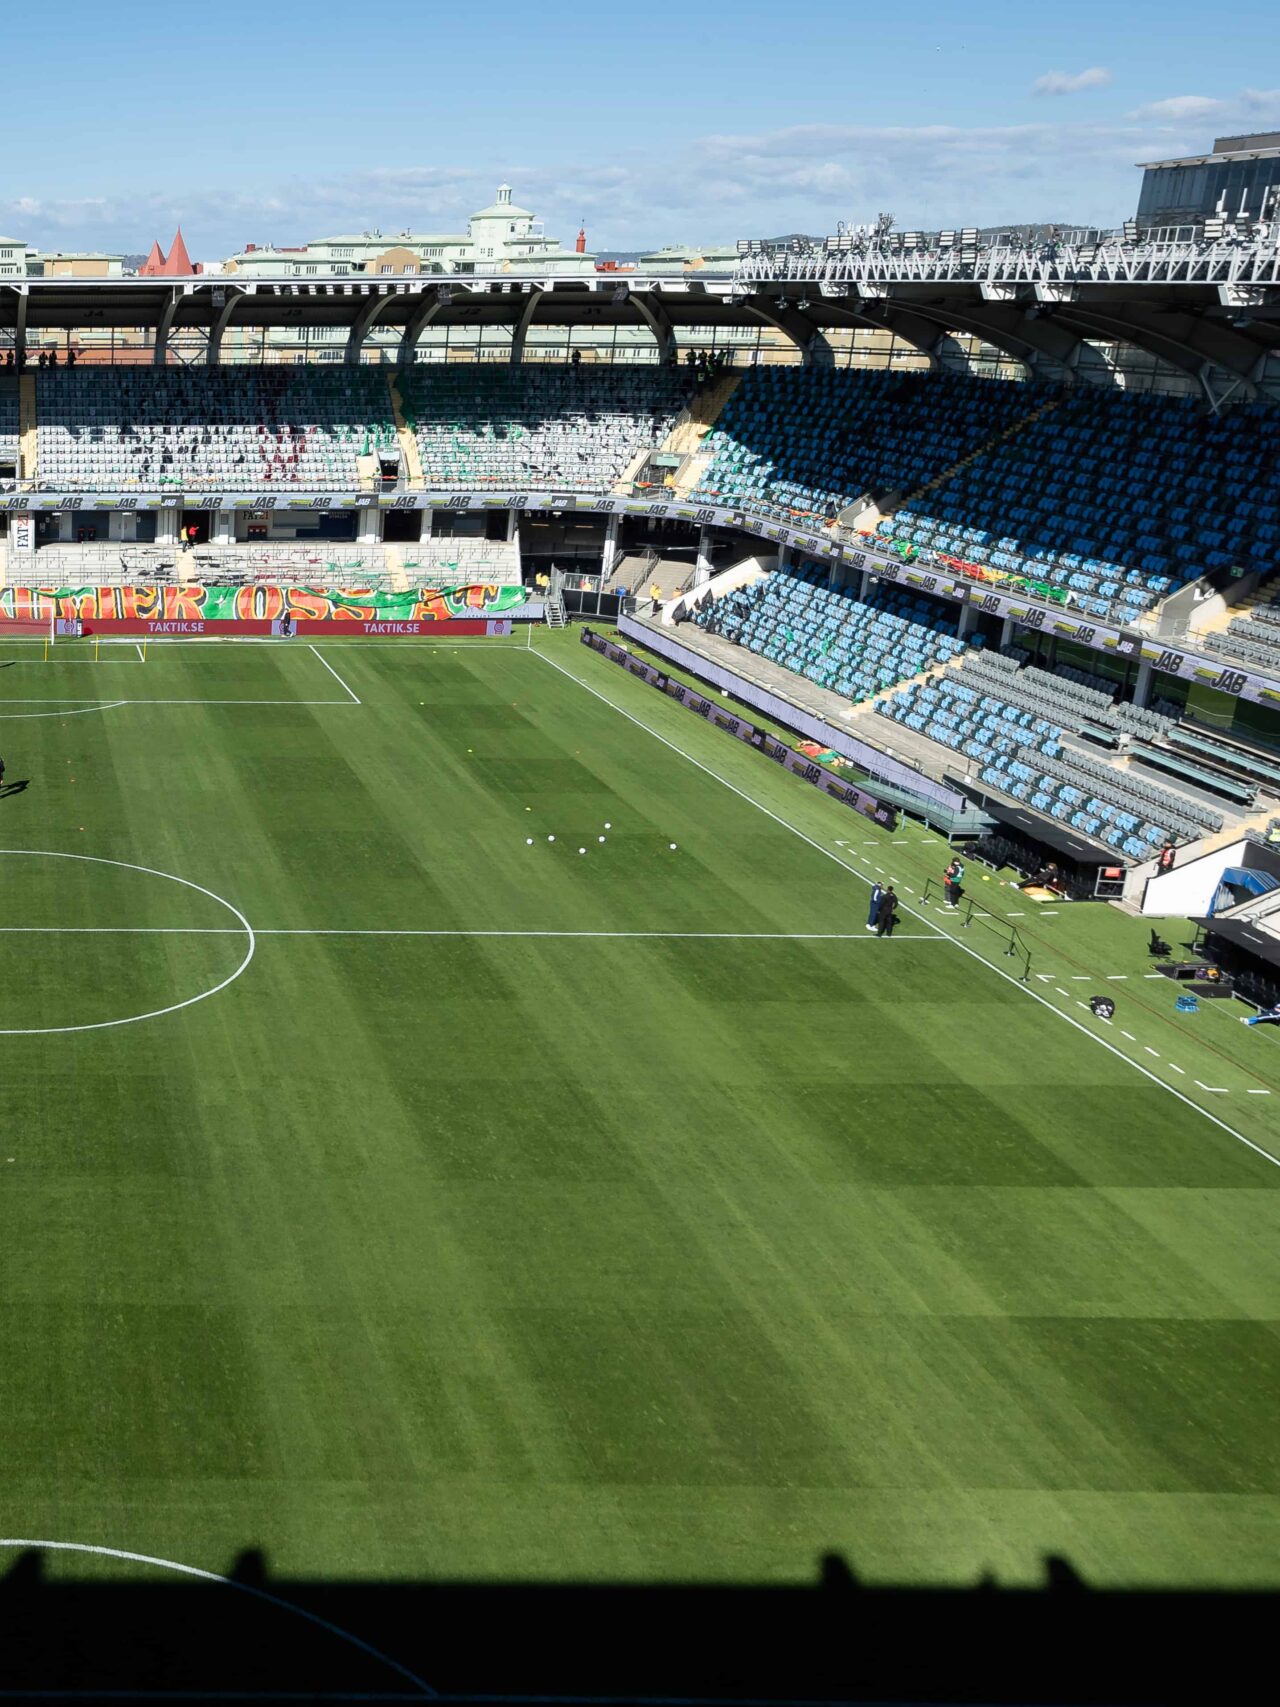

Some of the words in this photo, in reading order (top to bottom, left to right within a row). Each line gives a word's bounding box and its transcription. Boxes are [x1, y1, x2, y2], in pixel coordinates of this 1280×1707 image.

[3, 498, 29, 509] JAB
[56, 497, 83, 509] JAB
[114, 498, 138, 509] JAB
[161, 499, 177, 507] JAB
[197, 497, 223, 509] JAB
[250, 496, 277, 509] JAB
[308, 497, 332, 508] JAB
[355, 498, 371, 506] JAB
[390, 496, 418, 508] JAB
[443, 496, 472, 508] JAB
[503, 496, 529, 508] JAB
[552, 499, 568, 507] JAB
[591, 499, 616, 511] JAB
[645, 505, 669, 516] JAB
[692, 509, 716, 523] JAB
[17, 513, 29, 548] FAT21
[750, 520, 764, 534] JAB
[774, 528, 790, 543] JAB
[803, 537, 818, 552] JAB
[848, 552, 866, 568] JAB
[880, 563, 900, 580] JAB
[919, 576, 937, 591] JAB
[977, 594, 1001, 613] JAB
[1020, 607, 1046, 628] JAB
[148, 622, 204, 632] TAKTIK.SE
[364, 623, 420, 633] TAKTIK.SE
[1072, 624, 1096, 644] JAB
[1117, 640, 1134, 654] JAB
[1151, 650, 1184, 675] JAB
[1210, 668, 1248, 695] JAB
[672, 685, 686, 702] JAB
[696, 699, 711, 718] JAB
[725, 717, 740, 733] JAB
[770, 744, 788, 764] JAB
[801, 764, 822, 785] JAB
[841, 788, 860, 807] JAB
